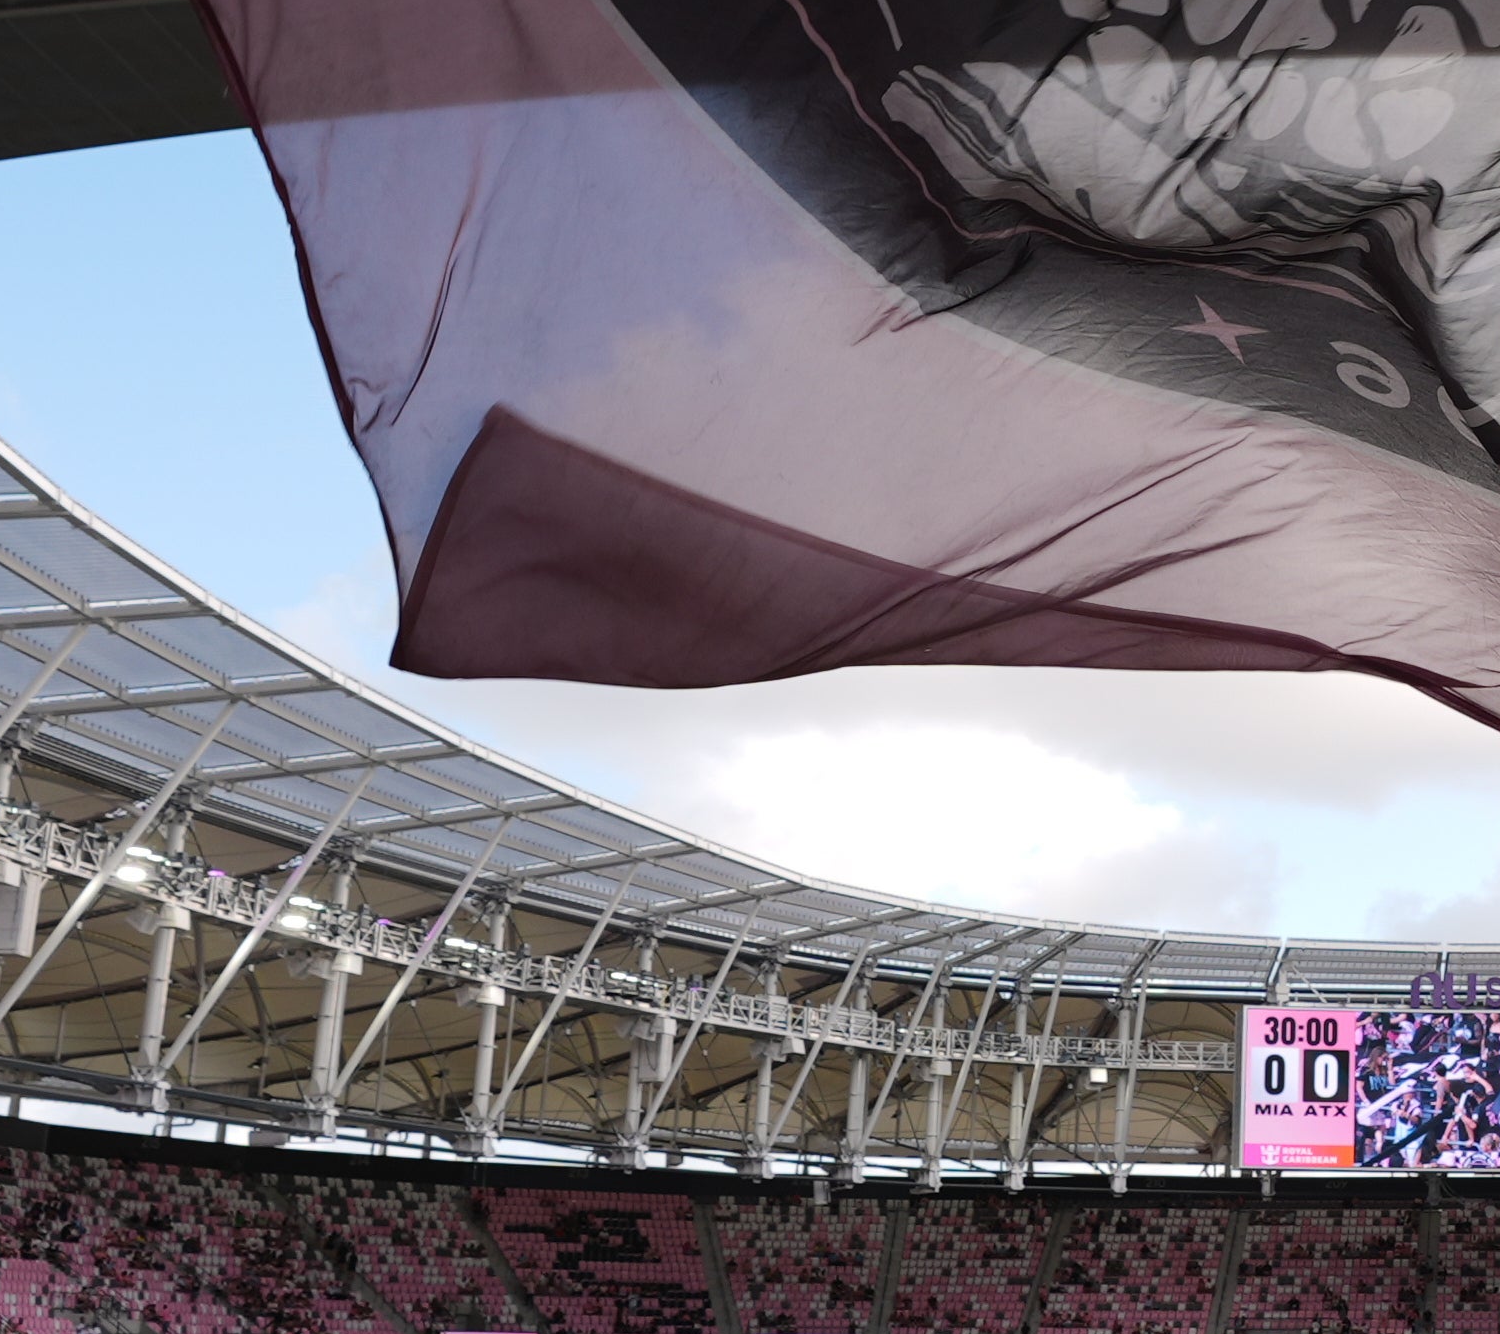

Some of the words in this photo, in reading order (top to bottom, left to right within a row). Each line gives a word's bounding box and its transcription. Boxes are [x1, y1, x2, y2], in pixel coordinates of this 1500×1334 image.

[1264, 1016, 1338, 1046] 30:00
[1264, 1054, 1285, 1095] 0
[1313, 1053, 1339, 1099] 0
[1255, 1104, 1294, 1116] MIA
[1303, 1104, 1347, 1117] ATX
[1282, 1146, 1313, 1155] ROYAL
[1282, 1155, 1337, 1164] CARIBBEAN
